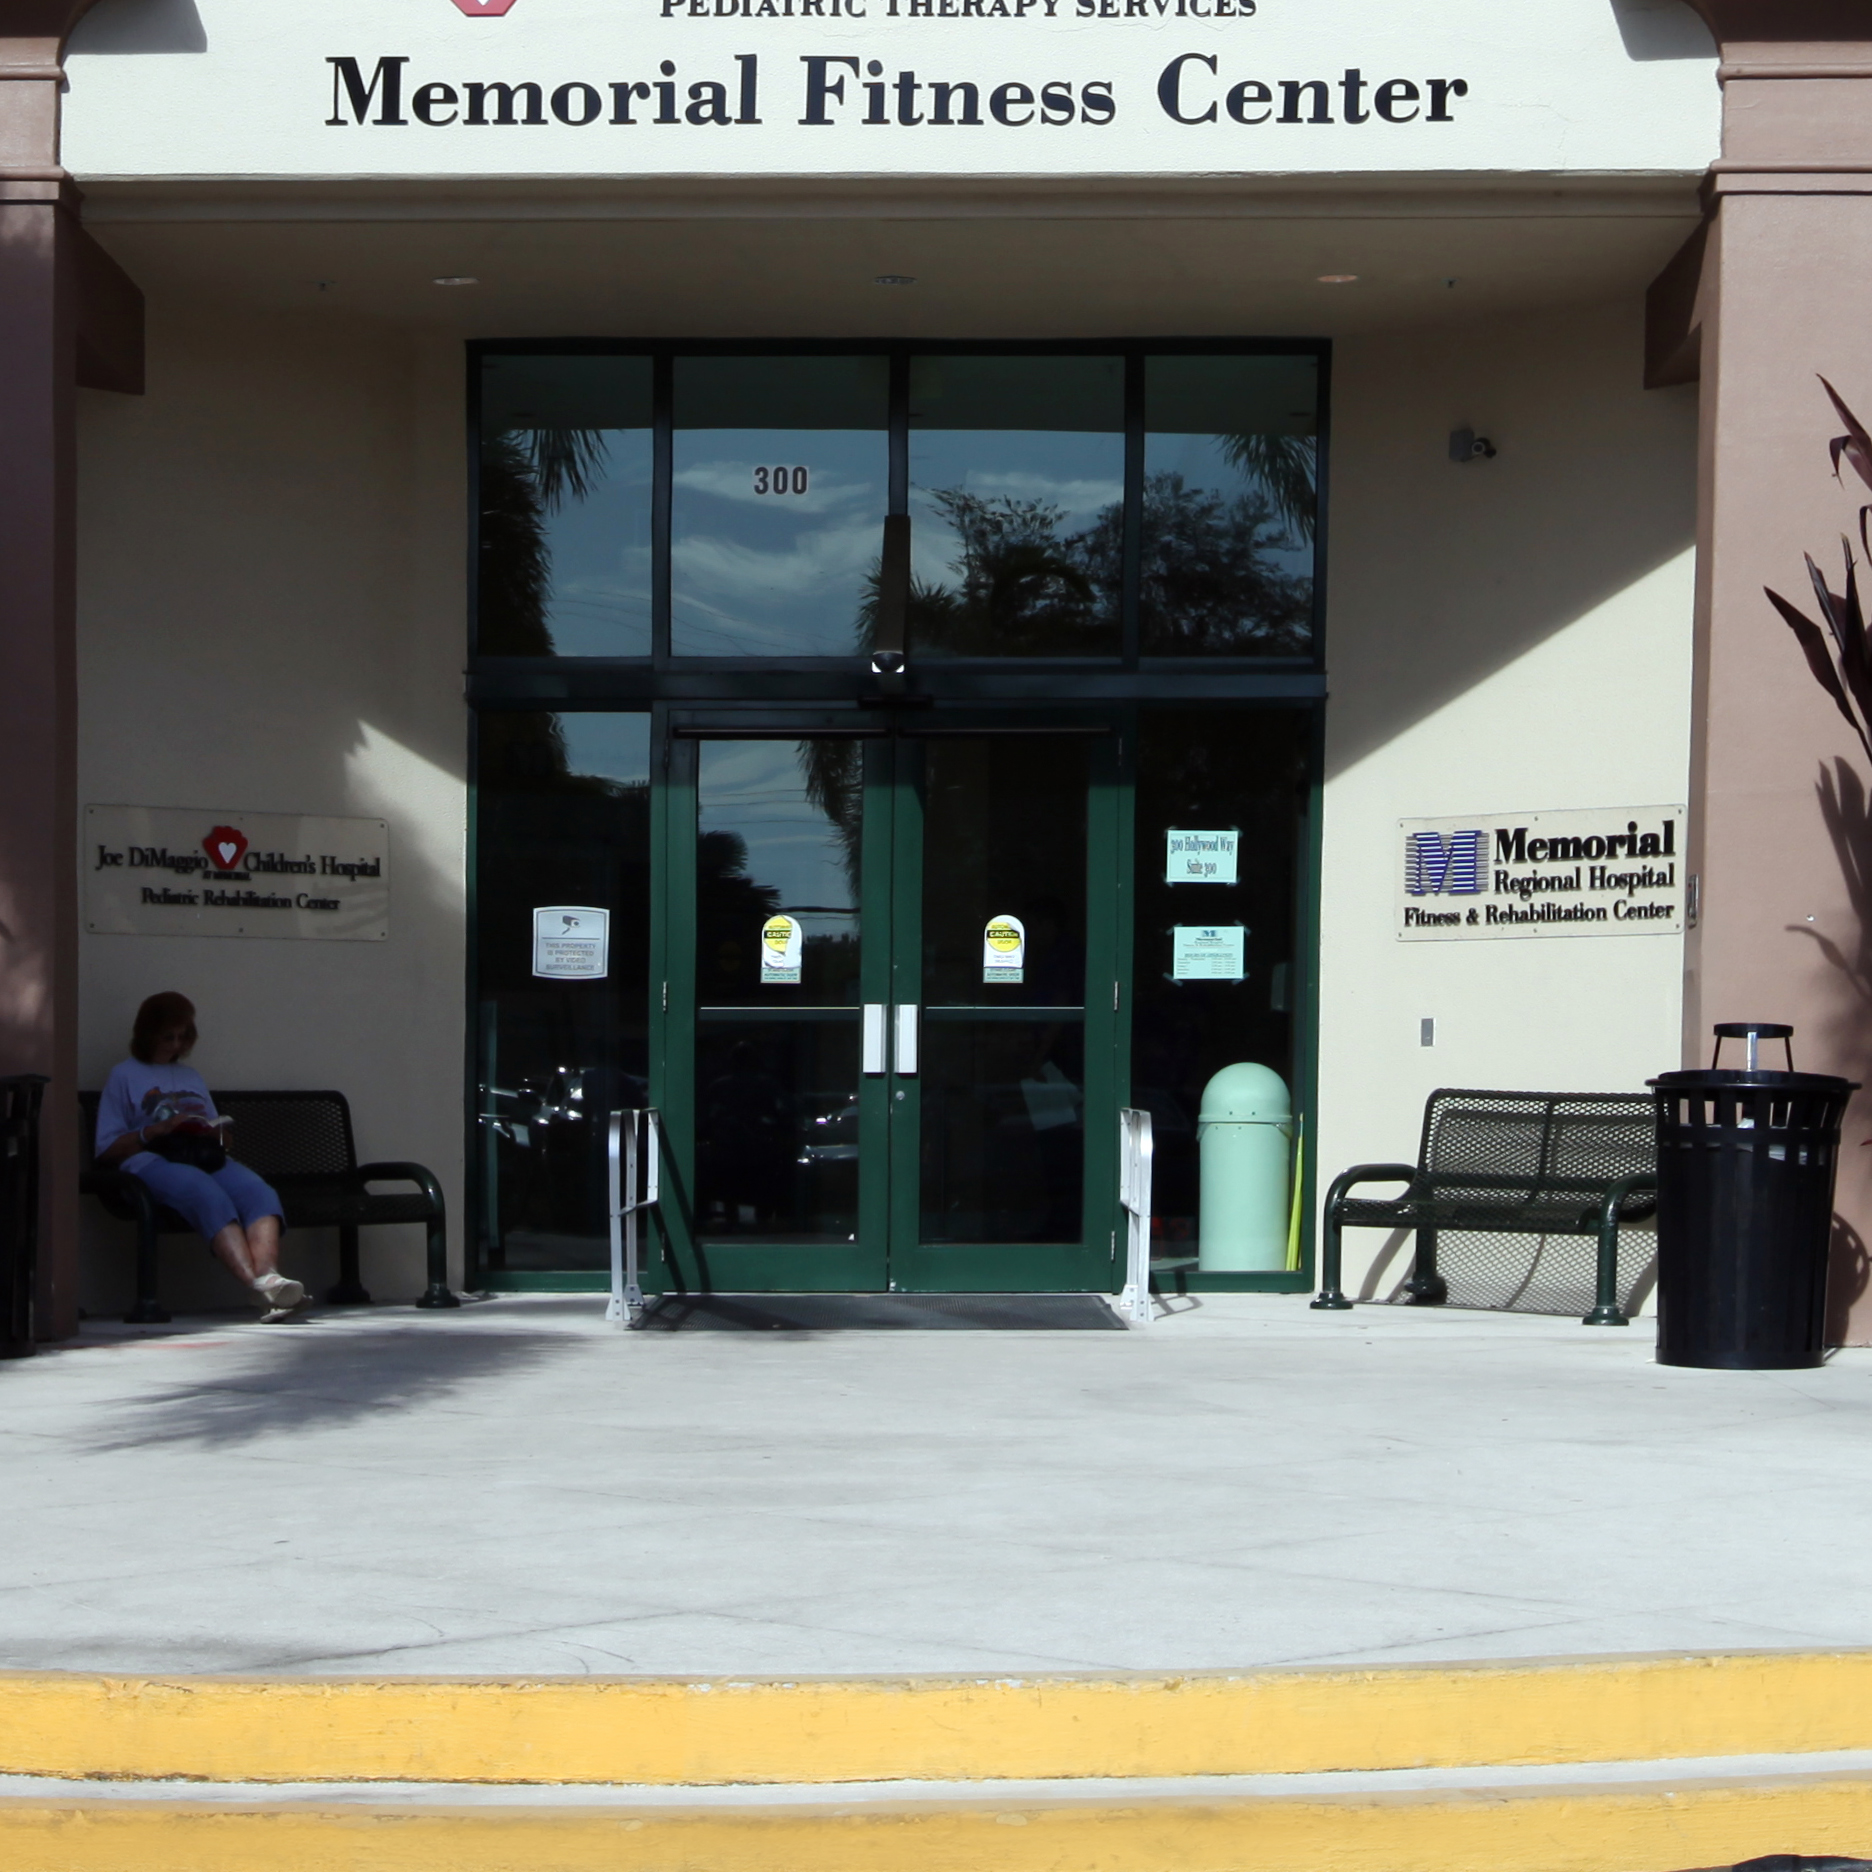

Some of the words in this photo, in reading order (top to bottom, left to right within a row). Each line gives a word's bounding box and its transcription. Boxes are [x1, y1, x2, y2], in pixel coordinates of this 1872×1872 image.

[324, 53, 764, 128] Memorial
[797, 54, 1117, 128] Fitness
[1156, 52, 1470, 126] Center
[753, 464, 809, 496] 300
[1493, 820, 1676, 865] Memorial
[95, 844, 124, 870] Joe
[129, 846, 209, 874] DiMaggio
[243, 852, 317, 875] Children's
[319, 855, 381, 882] Hospital
[1493, 866, 1582, 902] Regional
[1588, 862, 1675, 898] Hospital
[141, 887, 200, 906] Pediatric
[203, 889, 292, 909] Rehabilitation
[296, 893, 341, 911] Center
[1403, 905, 1461, 928] Fitness
[1466, 907, 1479, 925] &
[1485, 902, 1608, 927] Rehabilitation
[1613, 899, 1675, 922] Center
